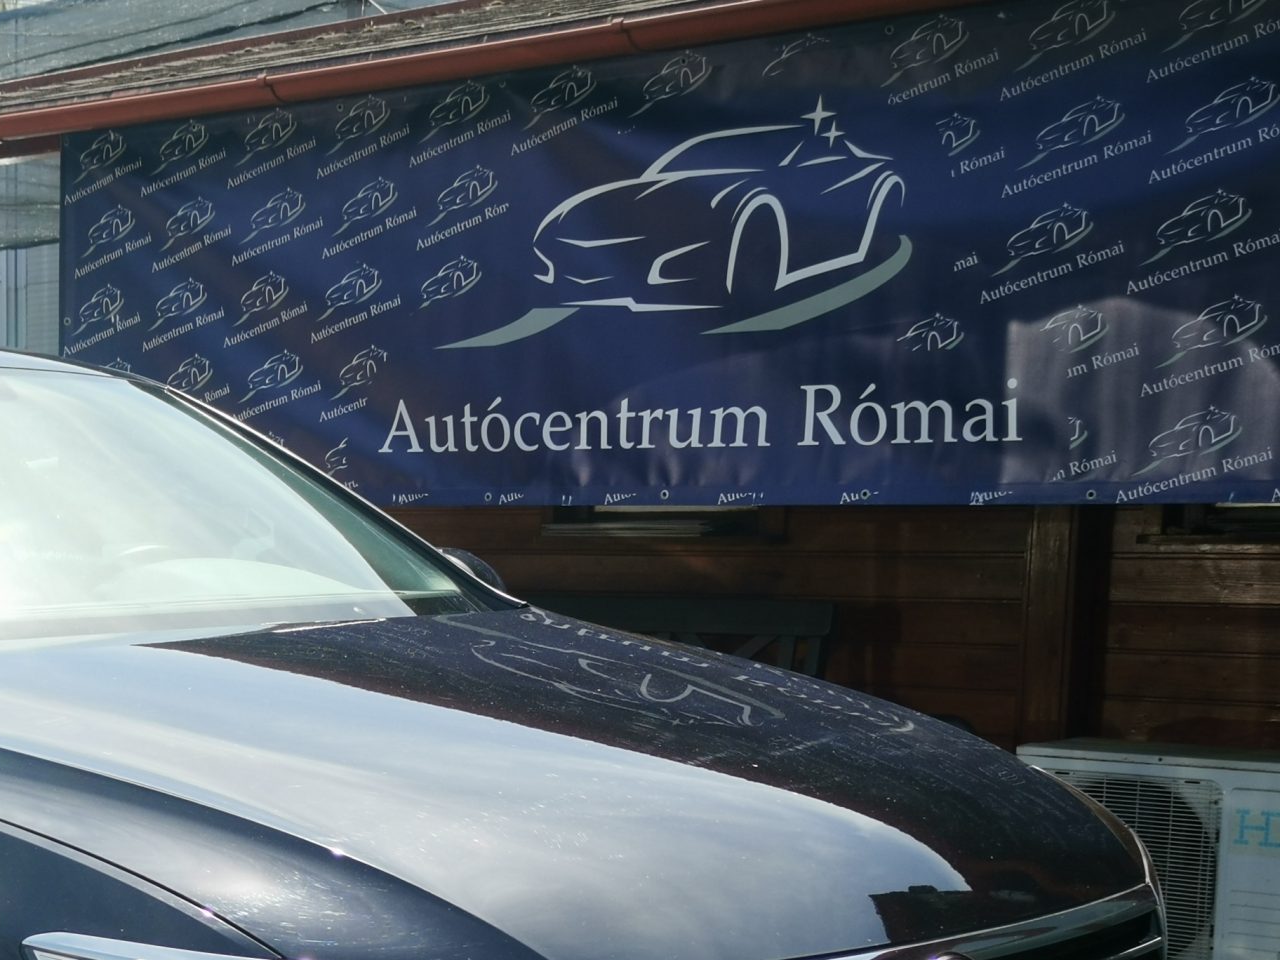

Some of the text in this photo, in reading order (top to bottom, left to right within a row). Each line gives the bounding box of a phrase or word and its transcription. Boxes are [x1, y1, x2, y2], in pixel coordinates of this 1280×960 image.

[954, 48, 1000, 78] Római
[1000, 28, 1147, 101] Autócentrum Római
[1147, 33, 1250, 83] Autócentrum
[409, 110, 511, 168] Autócentrum Római
[510, 97, 618, 156] Autócentrum Római
[140, 148, 226, 197] Autócentrum Római
[227, 136, 317, 190] Autócentrum Római
[316, 124, 410, 180] Autócentrum Római
[960, 147, 1006, 174] Római
[1001, 130, 1153, 198] Autócentrum Római
[1149, 137, 1253, 184] Autócentrum
[64, 157, 142, 205] Autócentrum Római
[74, 232, 152, 279] Autócentrum Római
[152, 224, 232, 273] Autócentrum Római
[231, 216, 323, 267] Autócentrum Római
[322, 207, 417, 259] Autócentrum Római
[416, 214, 482, 251] Autócentrum
[980, 240, 1125, 304] Autócentrum Római
[1126, 228, 1280, 295] Autócentrum Róma
[63, 327, 115, 357] Autócentrum
[142, 307, 225, 353] Autócentrum Római
[223, 301, 308, 348] Autócentrum Római
[310, 294, 401, 344] Autócentrum Római
[1091, 343, 1140, 370] Római
[1140, 357, 1243, 397] Autócentrum
[291, 380, 322, 401] Római
[378, 377, 1024, 454] Autócentrum Római
[1070, 450, 1117, 476] Római
[1116, 446, 1273, 503] Autócentrum Római
